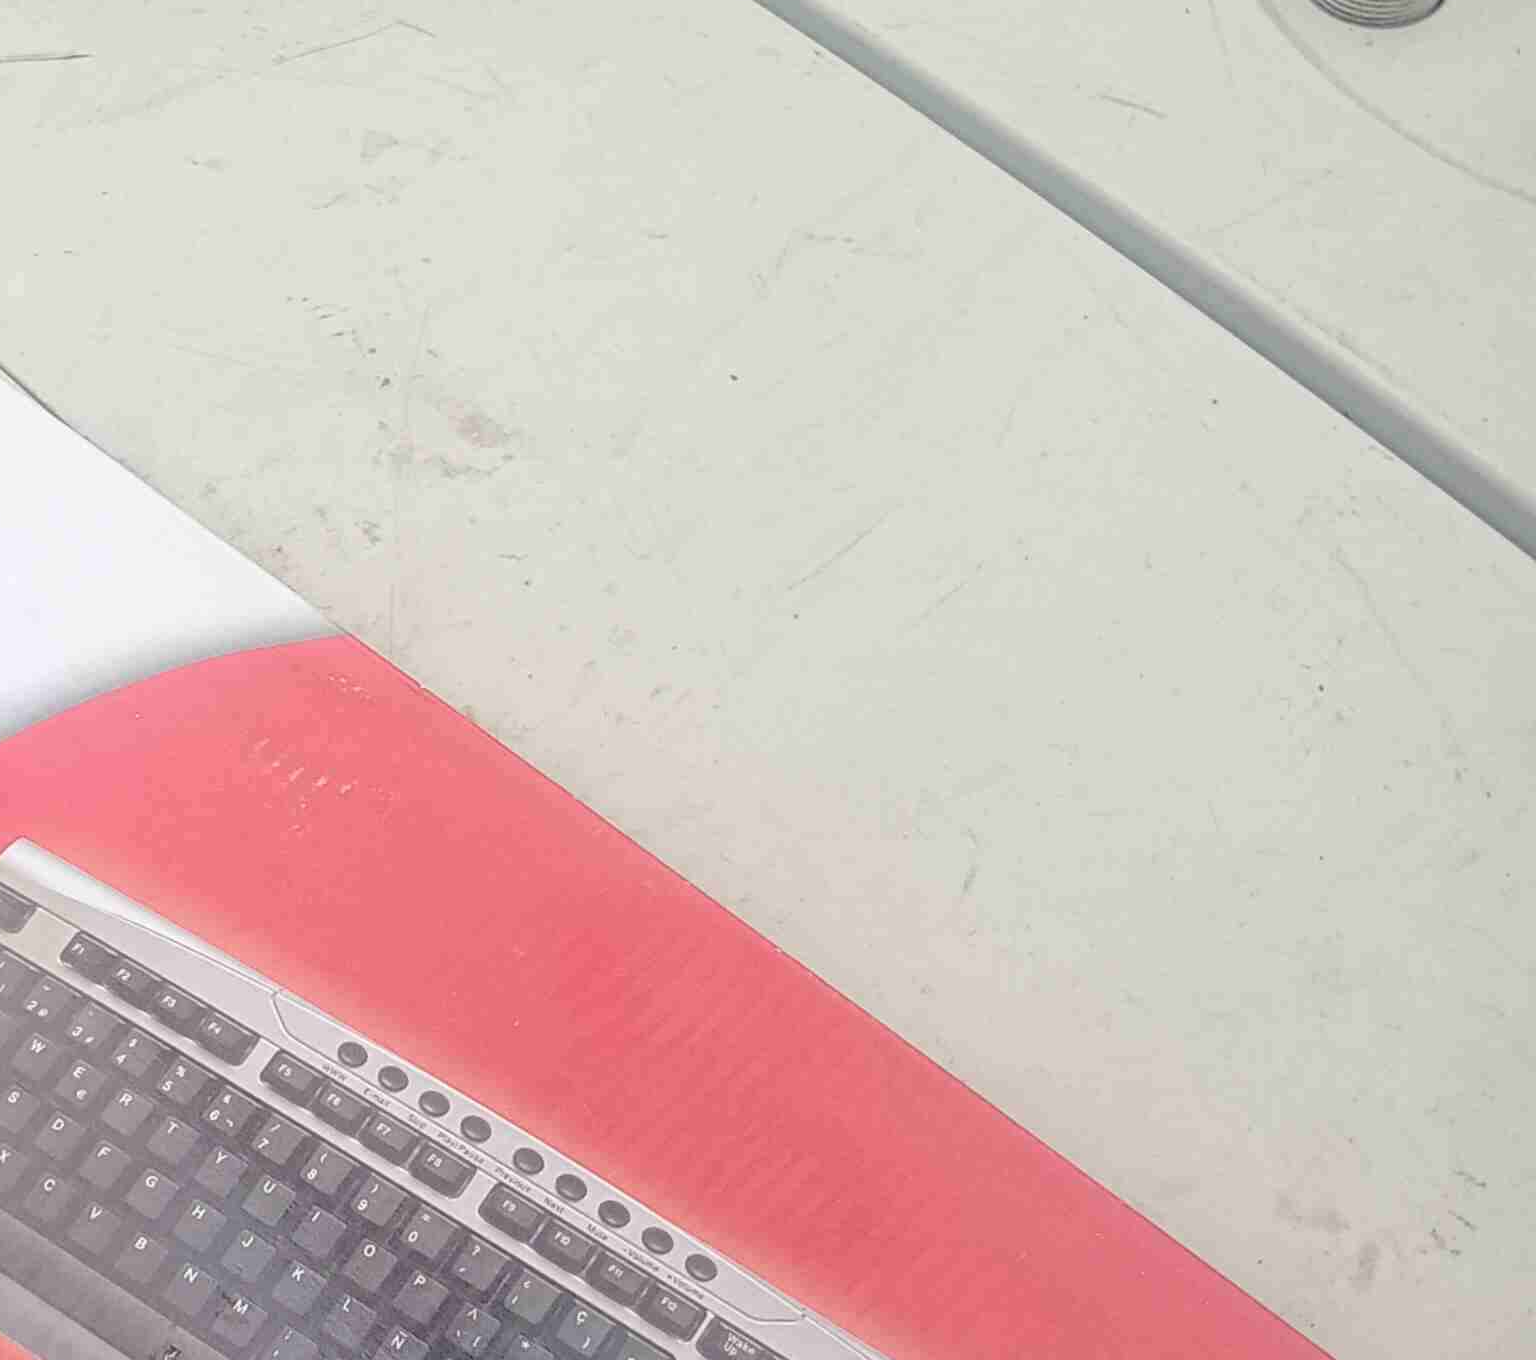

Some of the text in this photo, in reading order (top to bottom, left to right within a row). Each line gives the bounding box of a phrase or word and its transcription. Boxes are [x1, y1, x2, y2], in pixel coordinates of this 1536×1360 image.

[116, 968, 131, 981] F2
[26, 1000, 38, 1011] 2
[162, 995, 177, 1008] F3
[71, 1026, 84, 1037] 3
[207, 1022, 222, 1035] F4
[30, 1039, 46, 1053] W
[116, 1054, 127, 1065] 4
[72, 1066, 86, 1079] E
[161, 1080, 174, 1092] 5
[7, 1091, 20, 1104] S
[119, 1093, 133, 1106] R
[327, 1093, 341, 1106] F6
[51, 1118, 65, 1131] D
[167, 1121, 179, 1134] T
[376, 1122, 392, 1136] F7
[257, 1137, 270, 1149] 7
[97, 1146, 112, 1157] F
[215, 1151, 228, 1164] Y
[427, 1153, 443, 1168] F8
[306, 1168, 318, 1180] 8
[43, 1178, 56, 1192] C
[145, 1175, 159, 1188] G
[263, 1180, 277, 1194] U
[357, 1199, 368, 1211] 9
[90, 1206, 103, 1219] V
[191, 1205, 206, 1220] H
[134, 1236, 148, 1250] B
[241, 1235, 254, 1248] J
[407, 1230, 419, 1243] 0
[363, 1244, 376, 1257] O
[183, 1267, 199, 1283] N
[291, 1266, 305, 1282] K
[413, 1274, 427, 1286] P
[232, 1298, 249, 1315] M
[342, 1296, 352, 1310] L
[576, 1311, 588, 1327] Ç
[390, 1330, 408, 1350] Ñ
